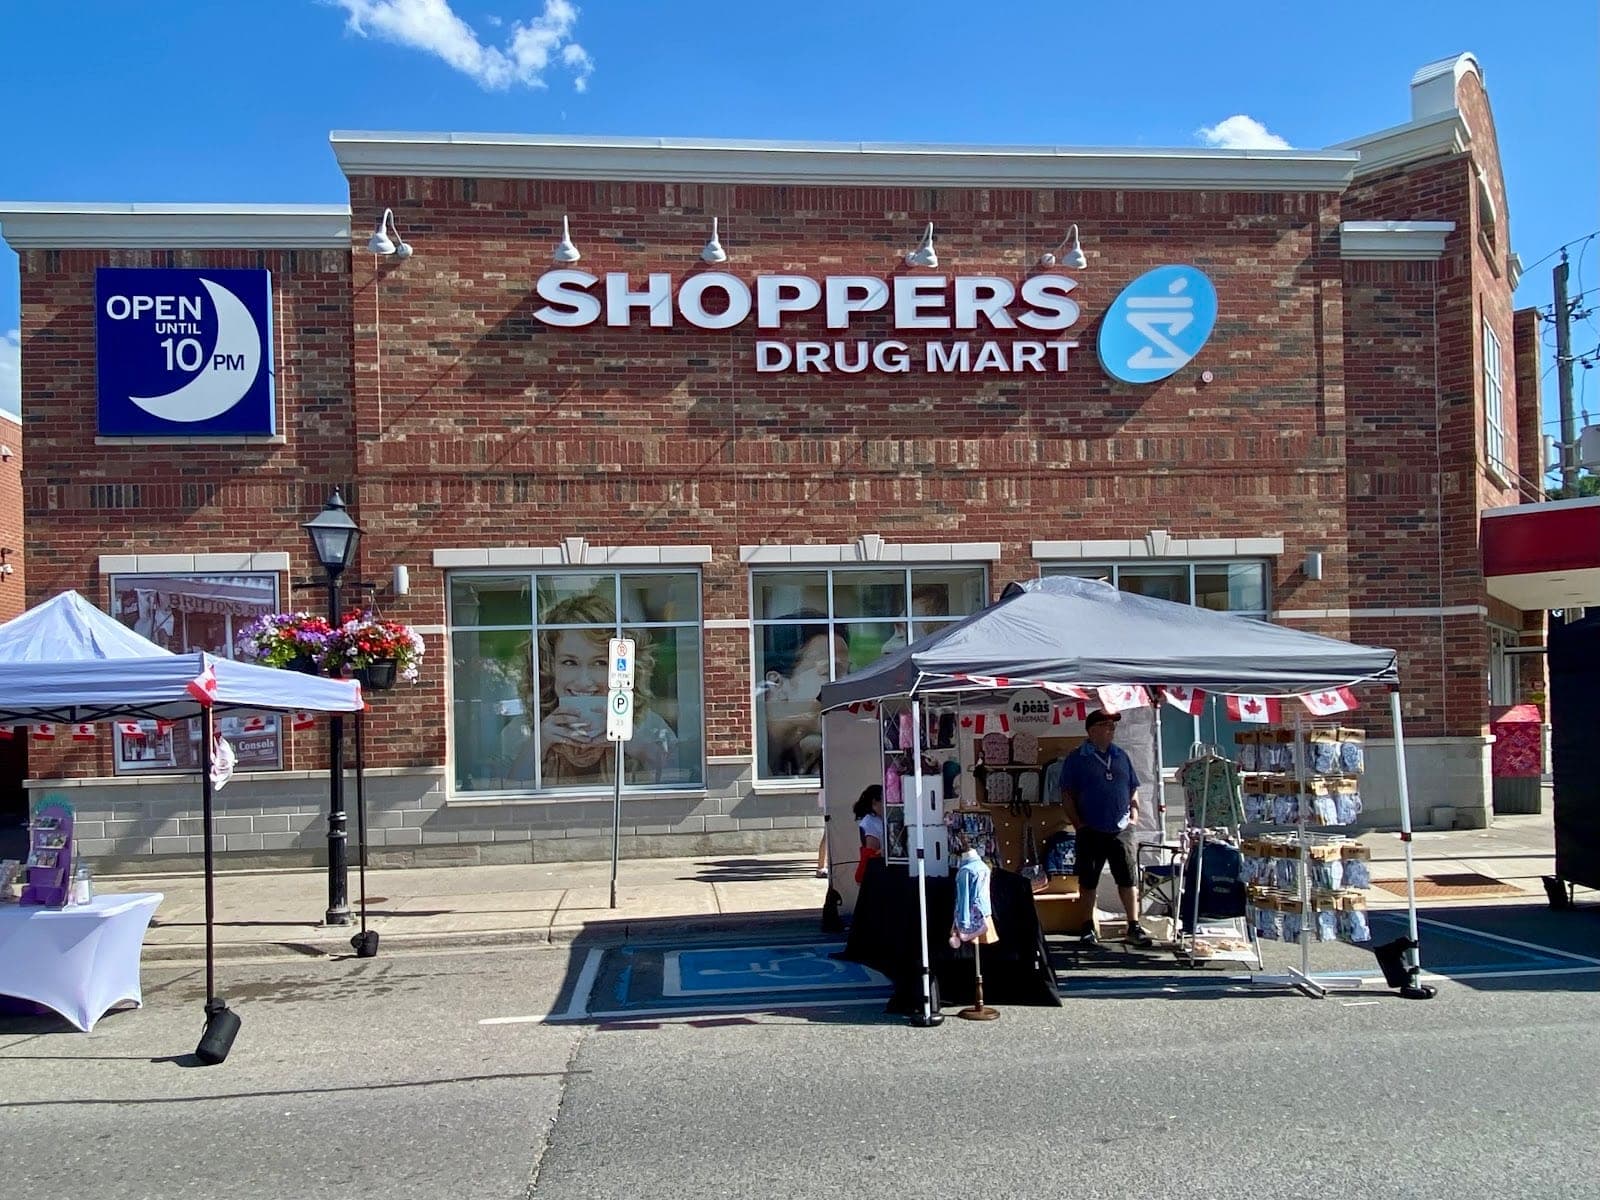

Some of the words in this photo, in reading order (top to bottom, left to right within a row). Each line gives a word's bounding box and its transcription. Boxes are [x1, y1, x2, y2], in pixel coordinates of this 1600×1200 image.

[106, 295, 202, 320] OPEN
[532, 269, 1080, 330] SHOPPERS
[155, 323, 202, 334] UNTIL
[160, 338, 203, 372] 10
[213, 354, 245, 371] PM
[756, 341, 910, 373] DRUG
[926, 341, 1079, 373] MART
[169, 593, 242, 615] BRITTONS
[617, 698, 625, 709] P
[1013, 702, 1021, 713] 4
[1022, 703, 1049, 715] peas
[239, 739, 274, 750] Consols
